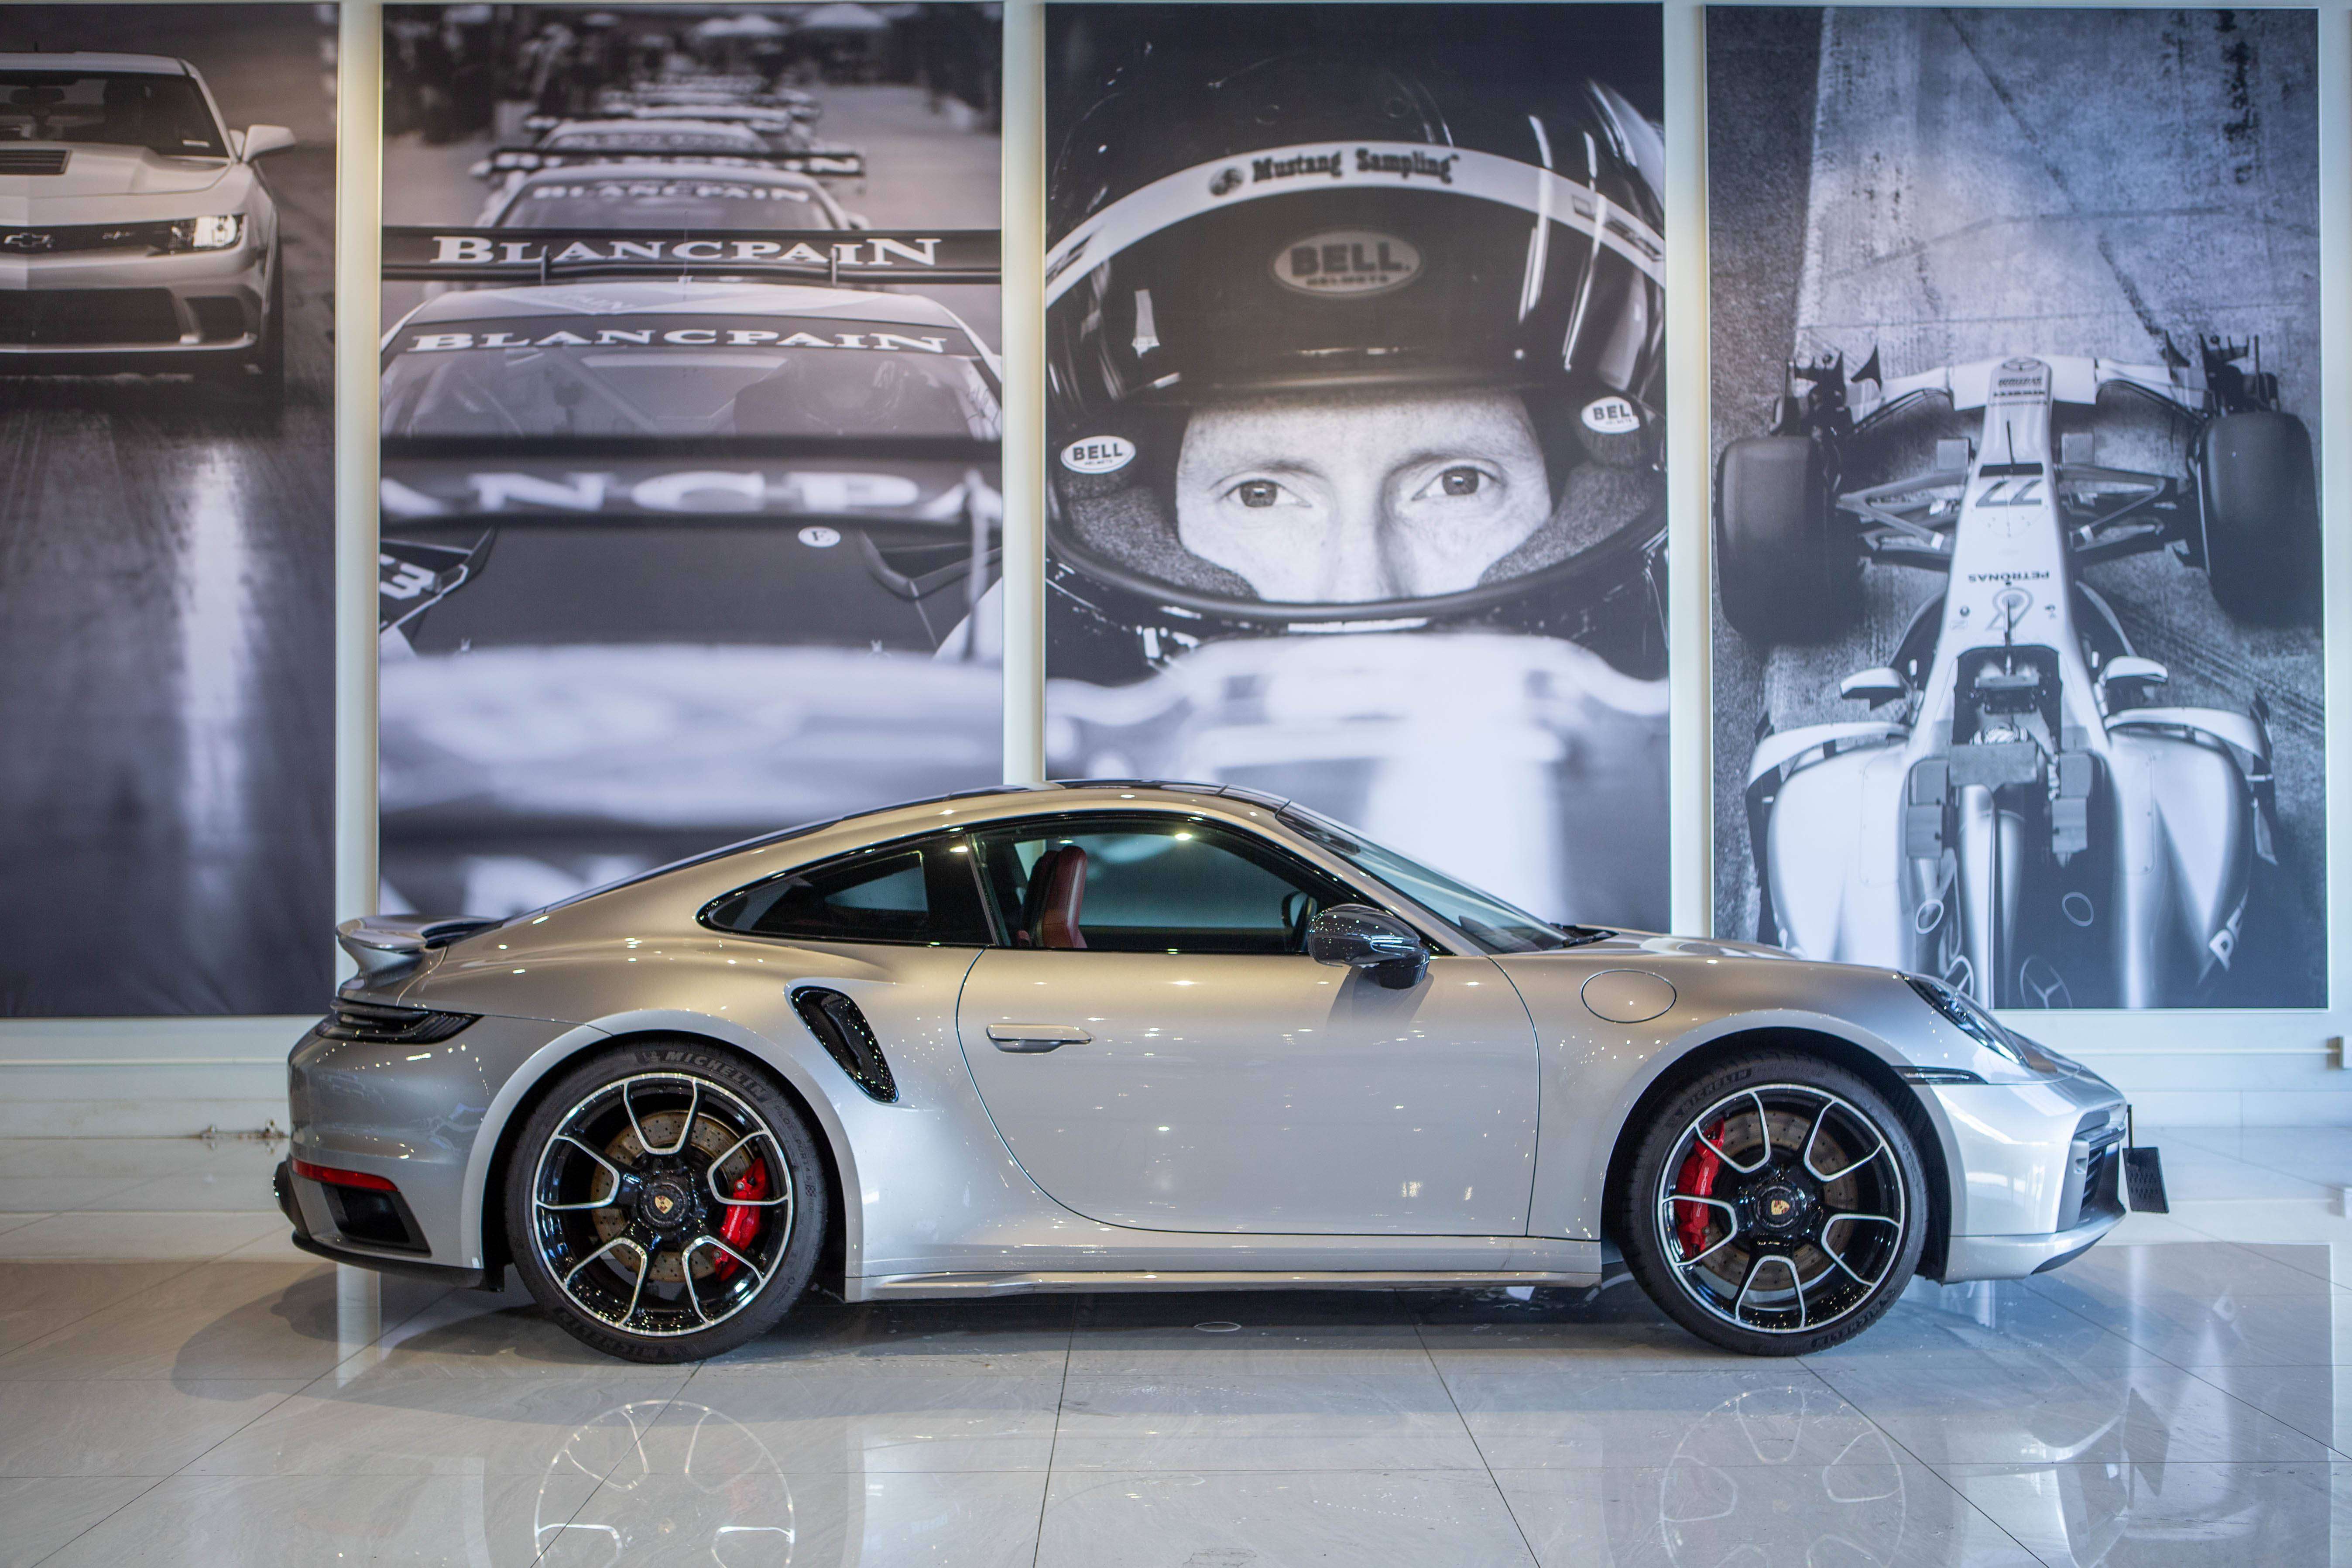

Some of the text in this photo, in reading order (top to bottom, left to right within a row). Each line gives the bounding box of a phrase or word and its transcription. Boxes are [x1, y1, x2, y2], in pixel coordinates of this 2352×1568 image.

[1252, 151, 1343, 182] Mustang
[430, 236, 942, 266] BLANCPAIN
[1290, 242, 1404, 277] BELL
[408, 329, 946, 353] BLANCPAIN
[1073, 443, 1122, 461] BELL
[1968, 571, 2050, 583] PETRONAS
[665, 1051, 766, 1098] MICHELIN
